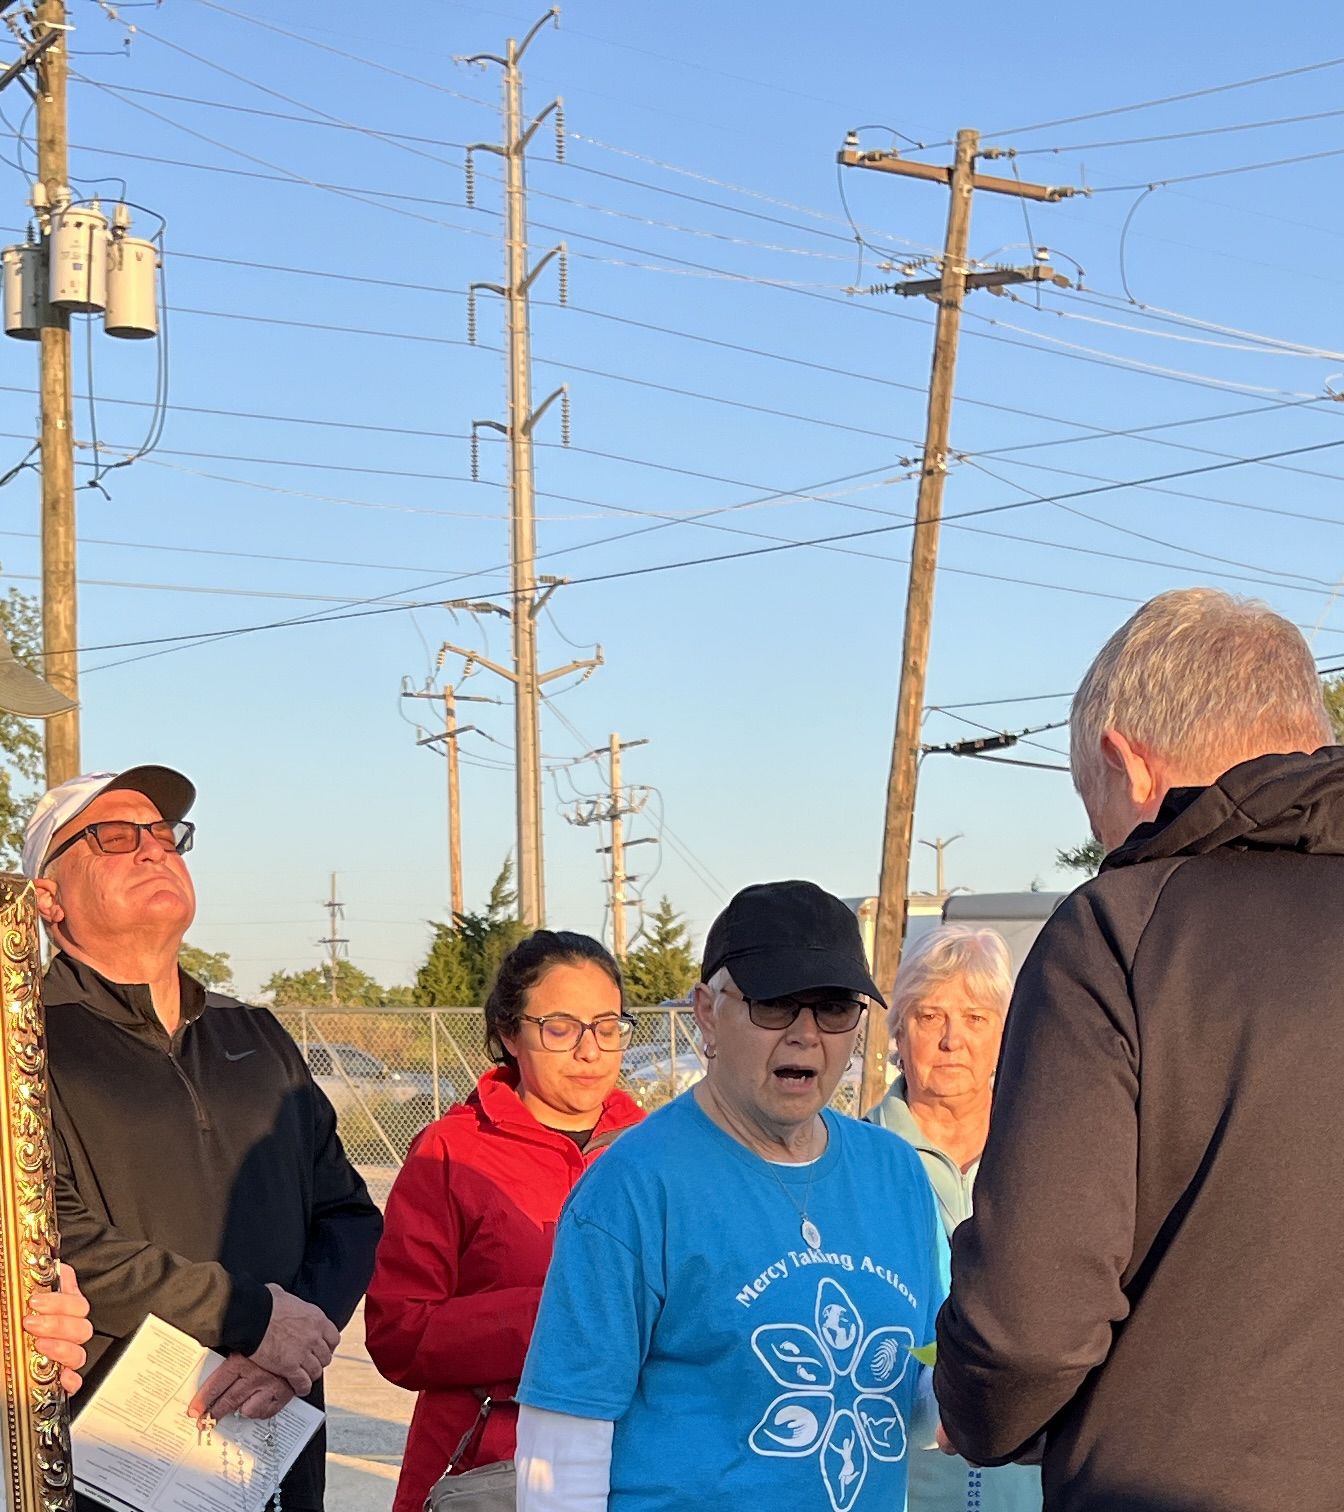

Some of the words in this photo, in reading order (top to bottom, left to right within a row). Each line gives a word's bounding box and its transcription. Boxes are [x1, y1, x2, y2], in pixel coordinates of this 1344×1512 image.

[735, 1258, 789, 1309] Mercy
[787, 1248, 854, 1272] Taking
[860, 1256, 918, 1309] Action
